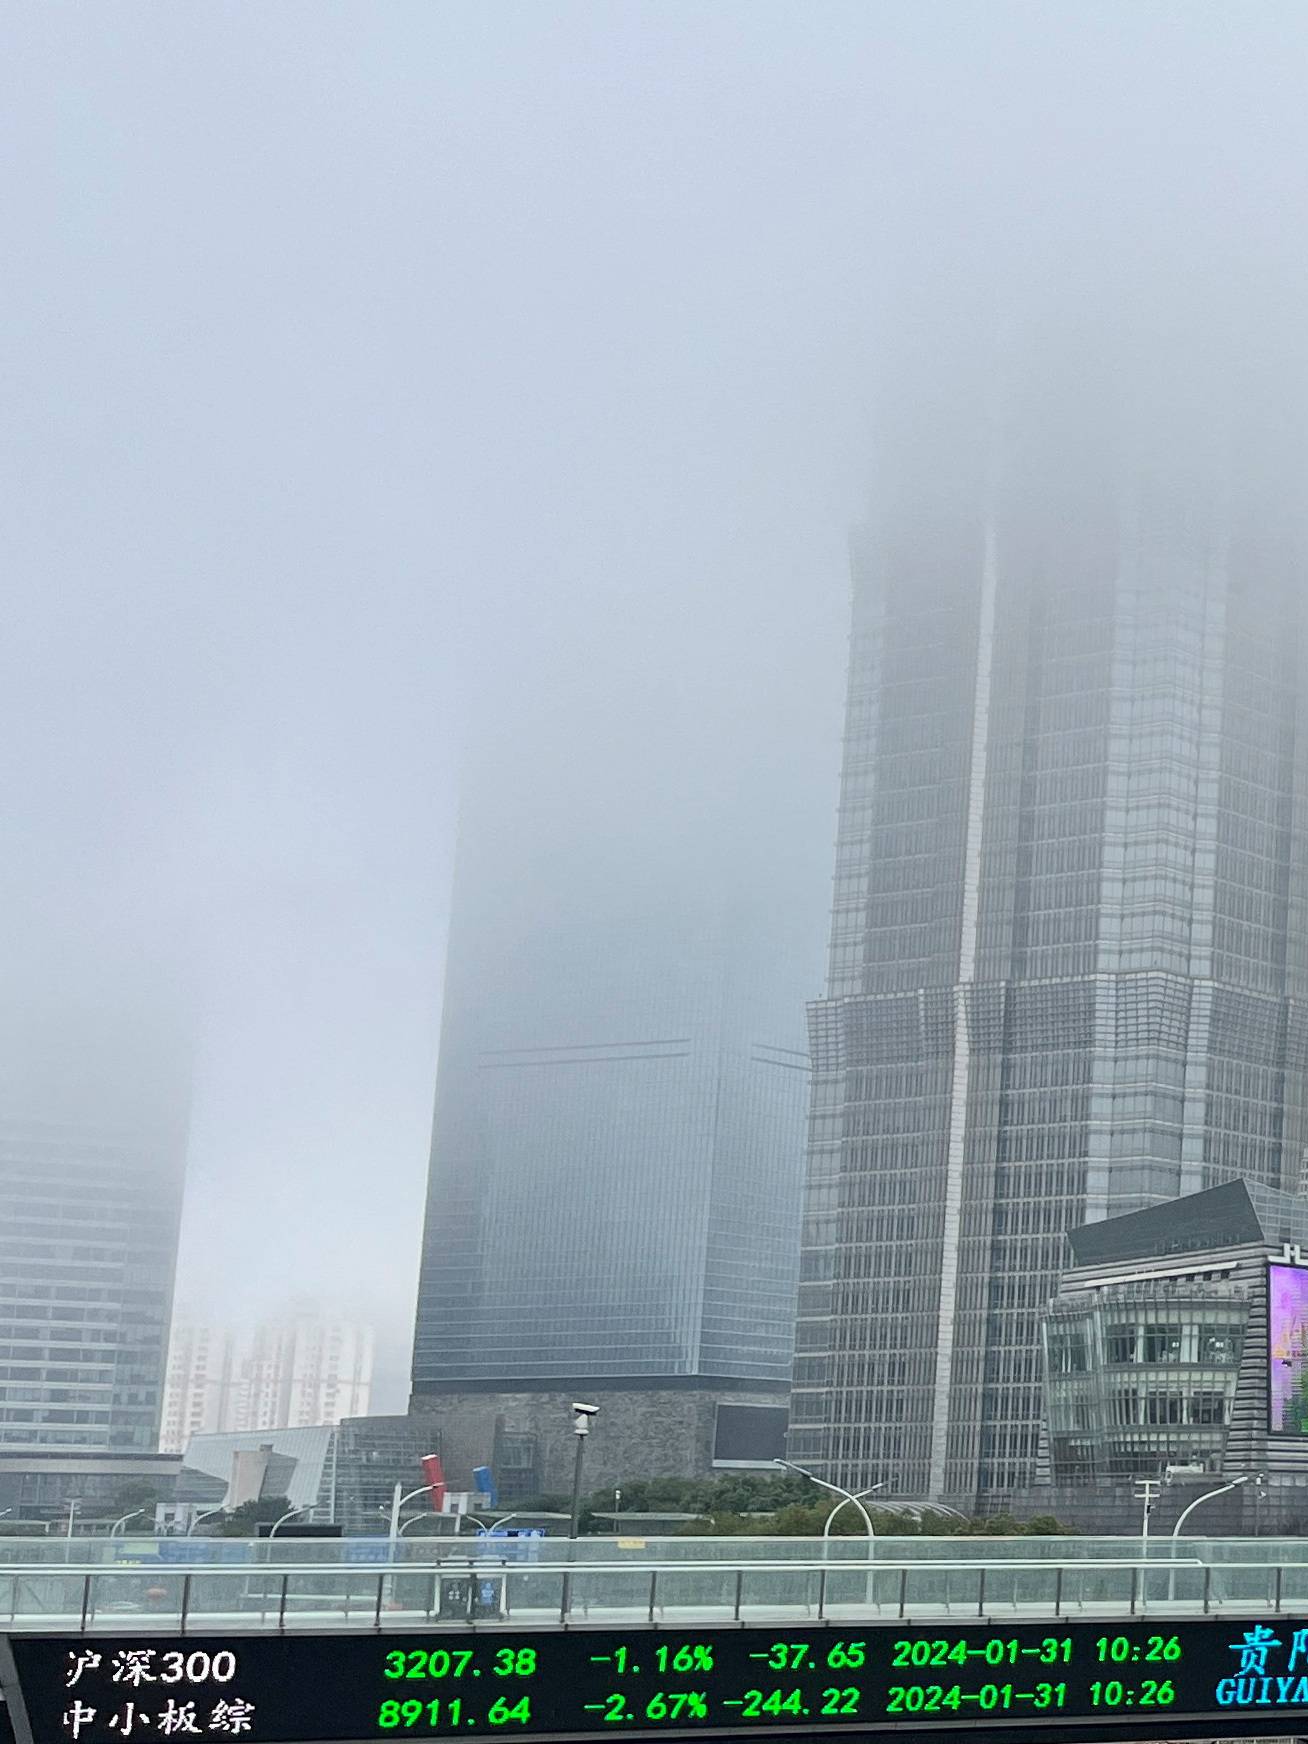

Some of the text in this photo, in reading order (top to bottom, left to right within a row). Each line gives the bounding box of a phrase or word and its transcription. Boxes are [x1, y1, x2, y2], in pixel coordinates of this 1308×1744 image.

[66, 1636, 1181, 1687] 沪深300 3207.38 -1.16% -37.65 2024-01-31 10:26
[63, 1679, 1175, 1739] 中小板综 8911.64 -2.67% -244.22 2024-01-31 10:26
